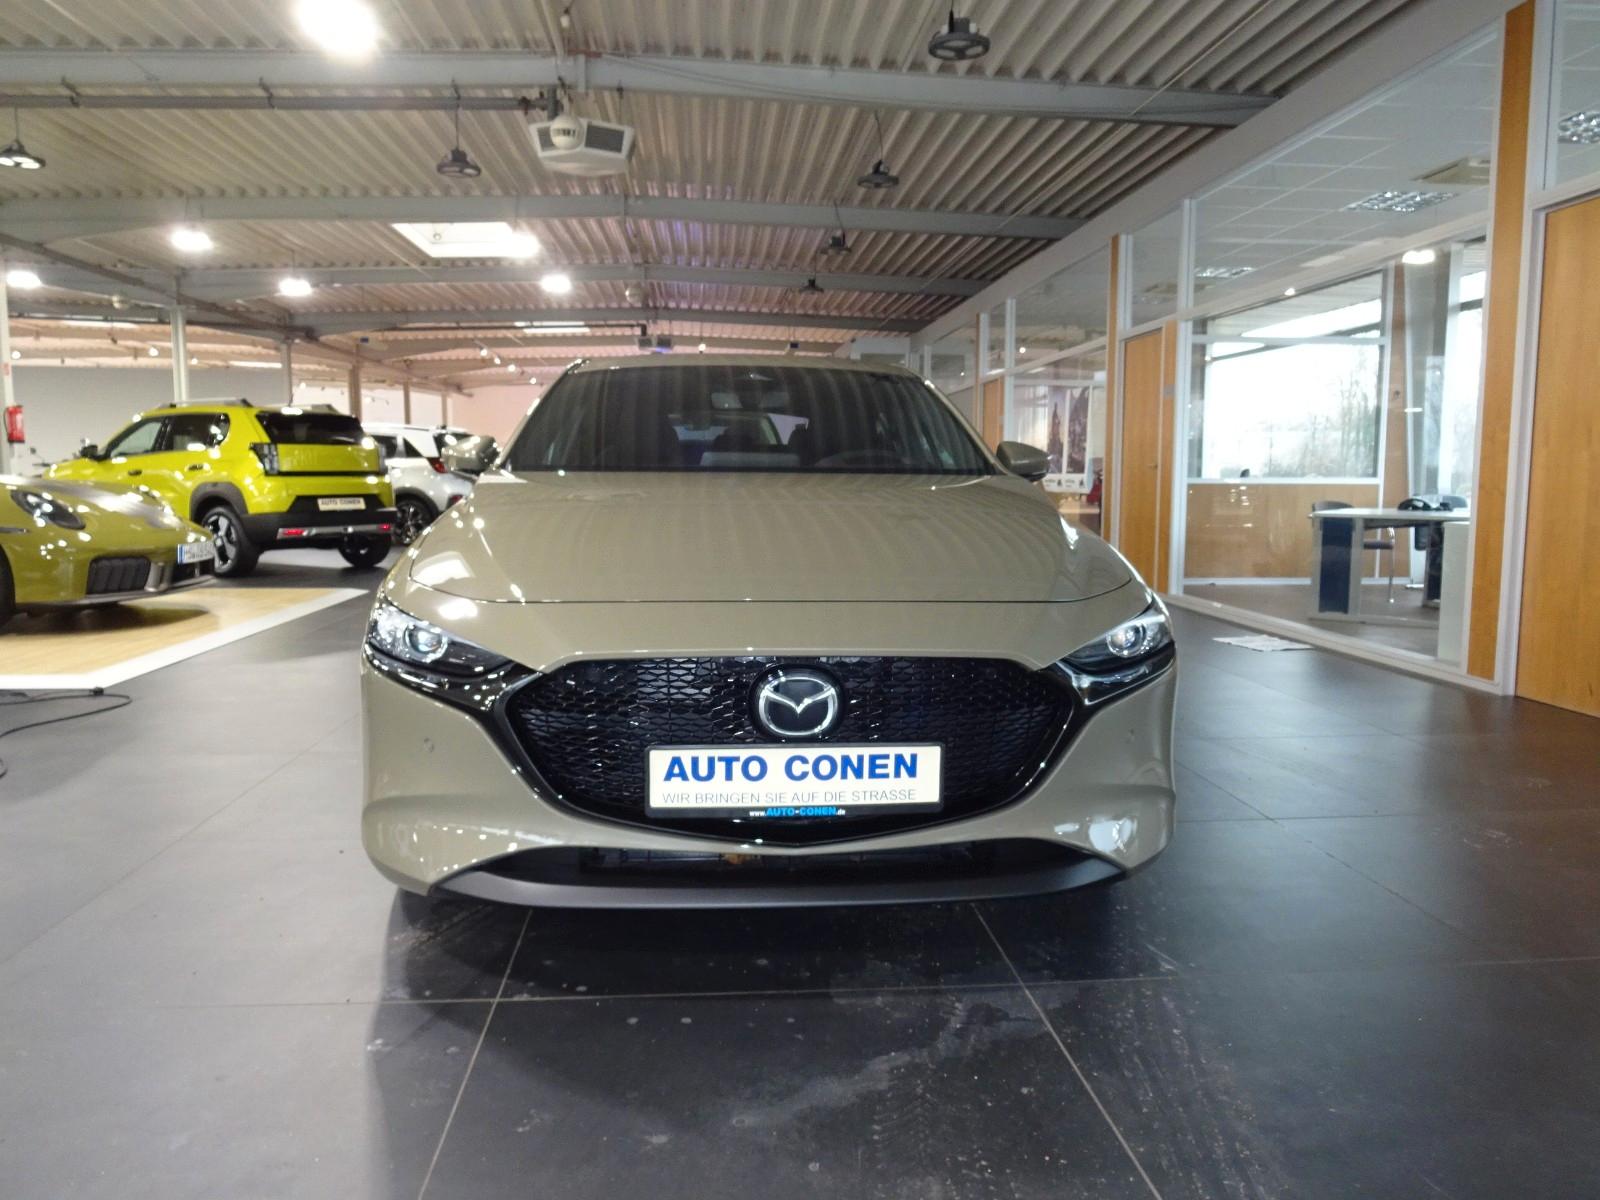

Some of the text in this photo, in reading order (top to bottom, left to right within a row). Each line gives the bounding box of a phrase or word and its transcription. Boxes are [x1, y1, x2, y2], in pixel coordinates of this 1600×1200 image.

[663, 753, 918, 782] AUTO CONEN
[662, 788, 917, 804] WIR BRINGEN SIE AUF DIE STRASSE
[749, 806, 846, 817] www.AUTO-CONEN.de
